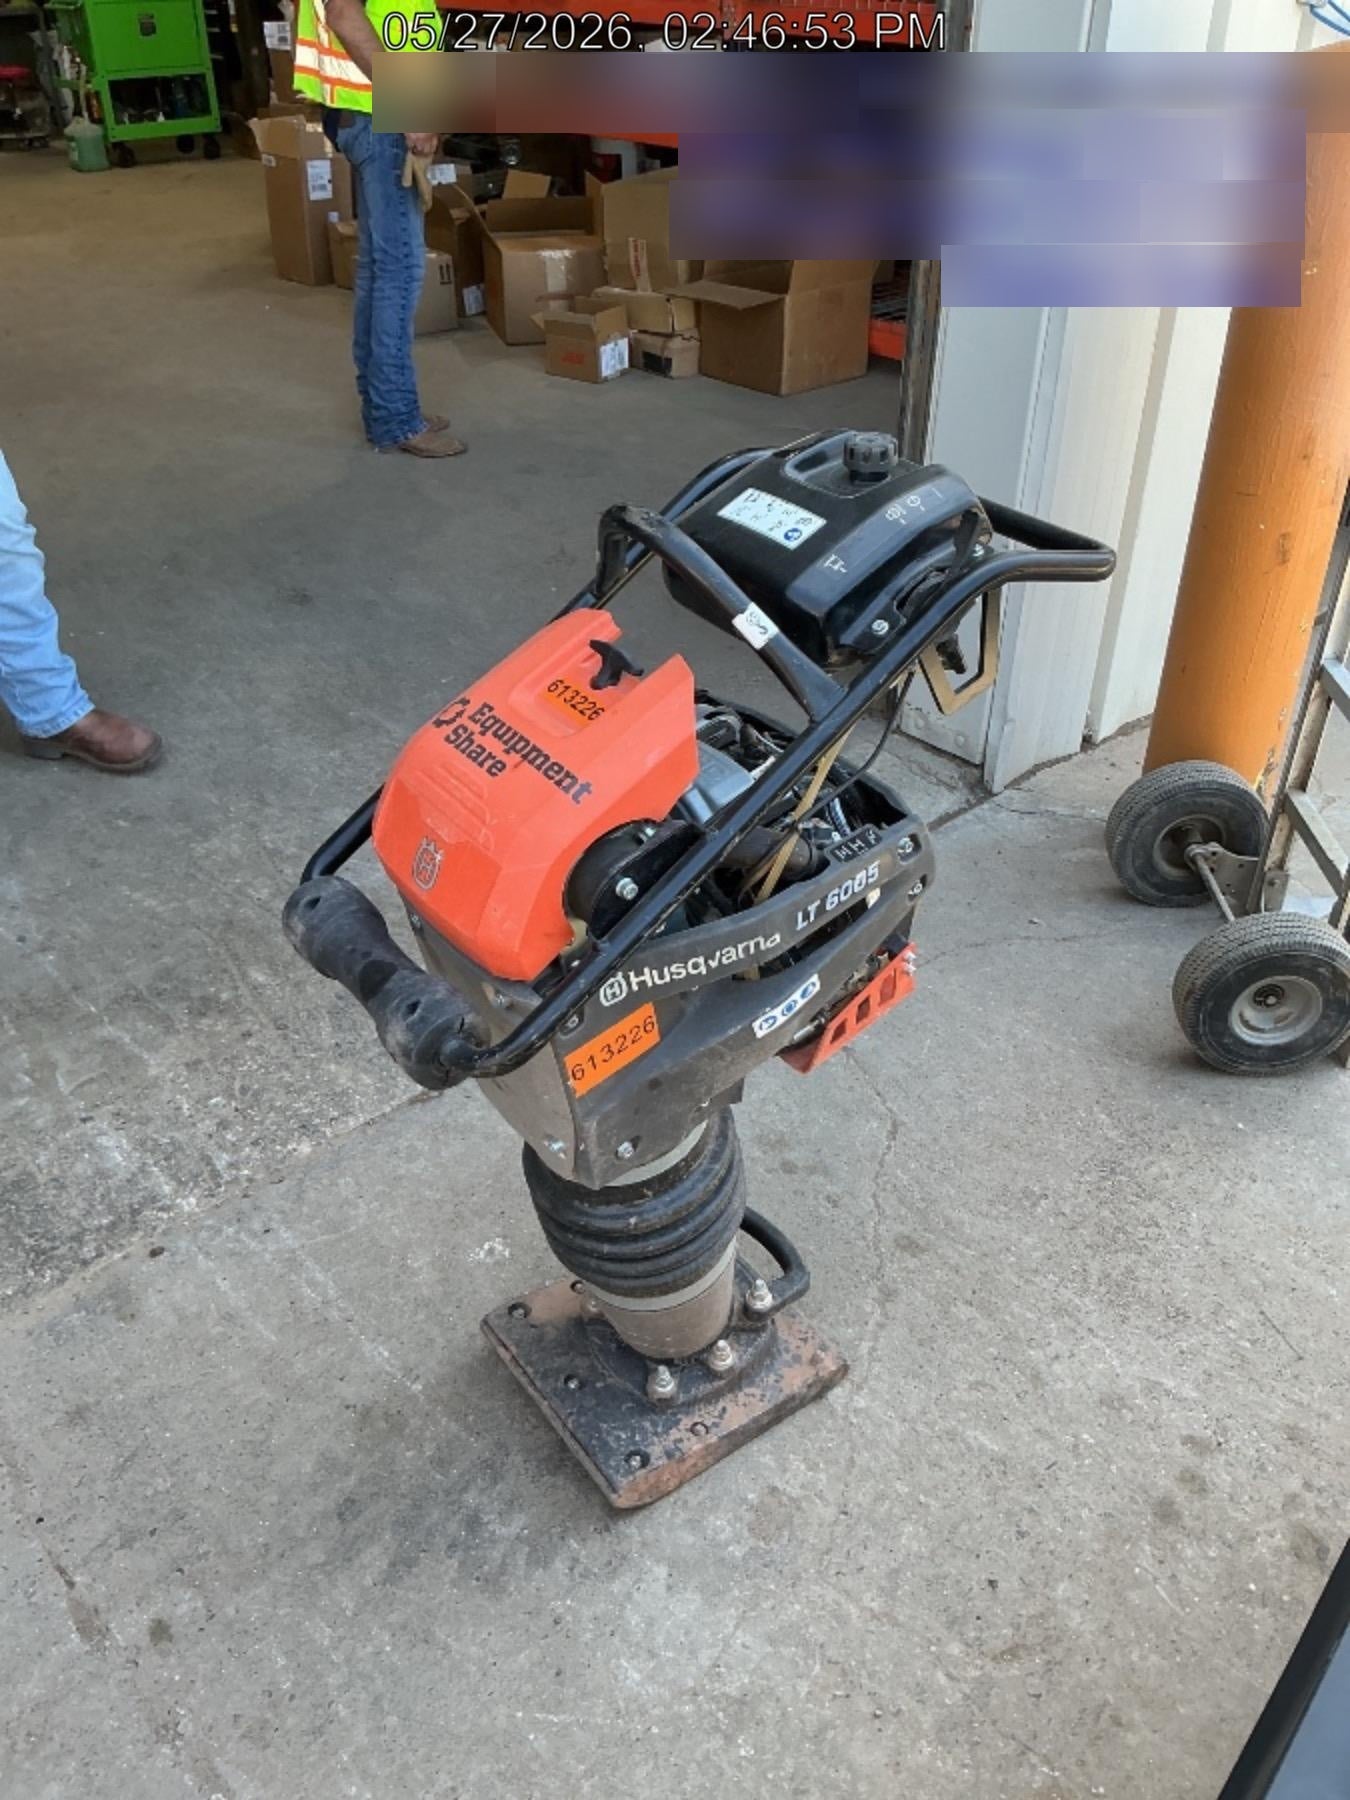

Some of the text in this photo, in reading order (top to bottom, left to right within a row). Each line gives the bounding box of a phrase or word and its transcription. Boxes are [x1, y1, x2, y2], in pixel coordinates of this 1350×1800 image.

[547, 678, 606, 721] 613226
[444, 724, 507, 777] Share
[468, 702, 592, 804] Equipment
[796, 861, 880, 930] LT 6005
[629, 933, 781, 992] Husqvarna
[571, 1016, 655, 1081] 613226
